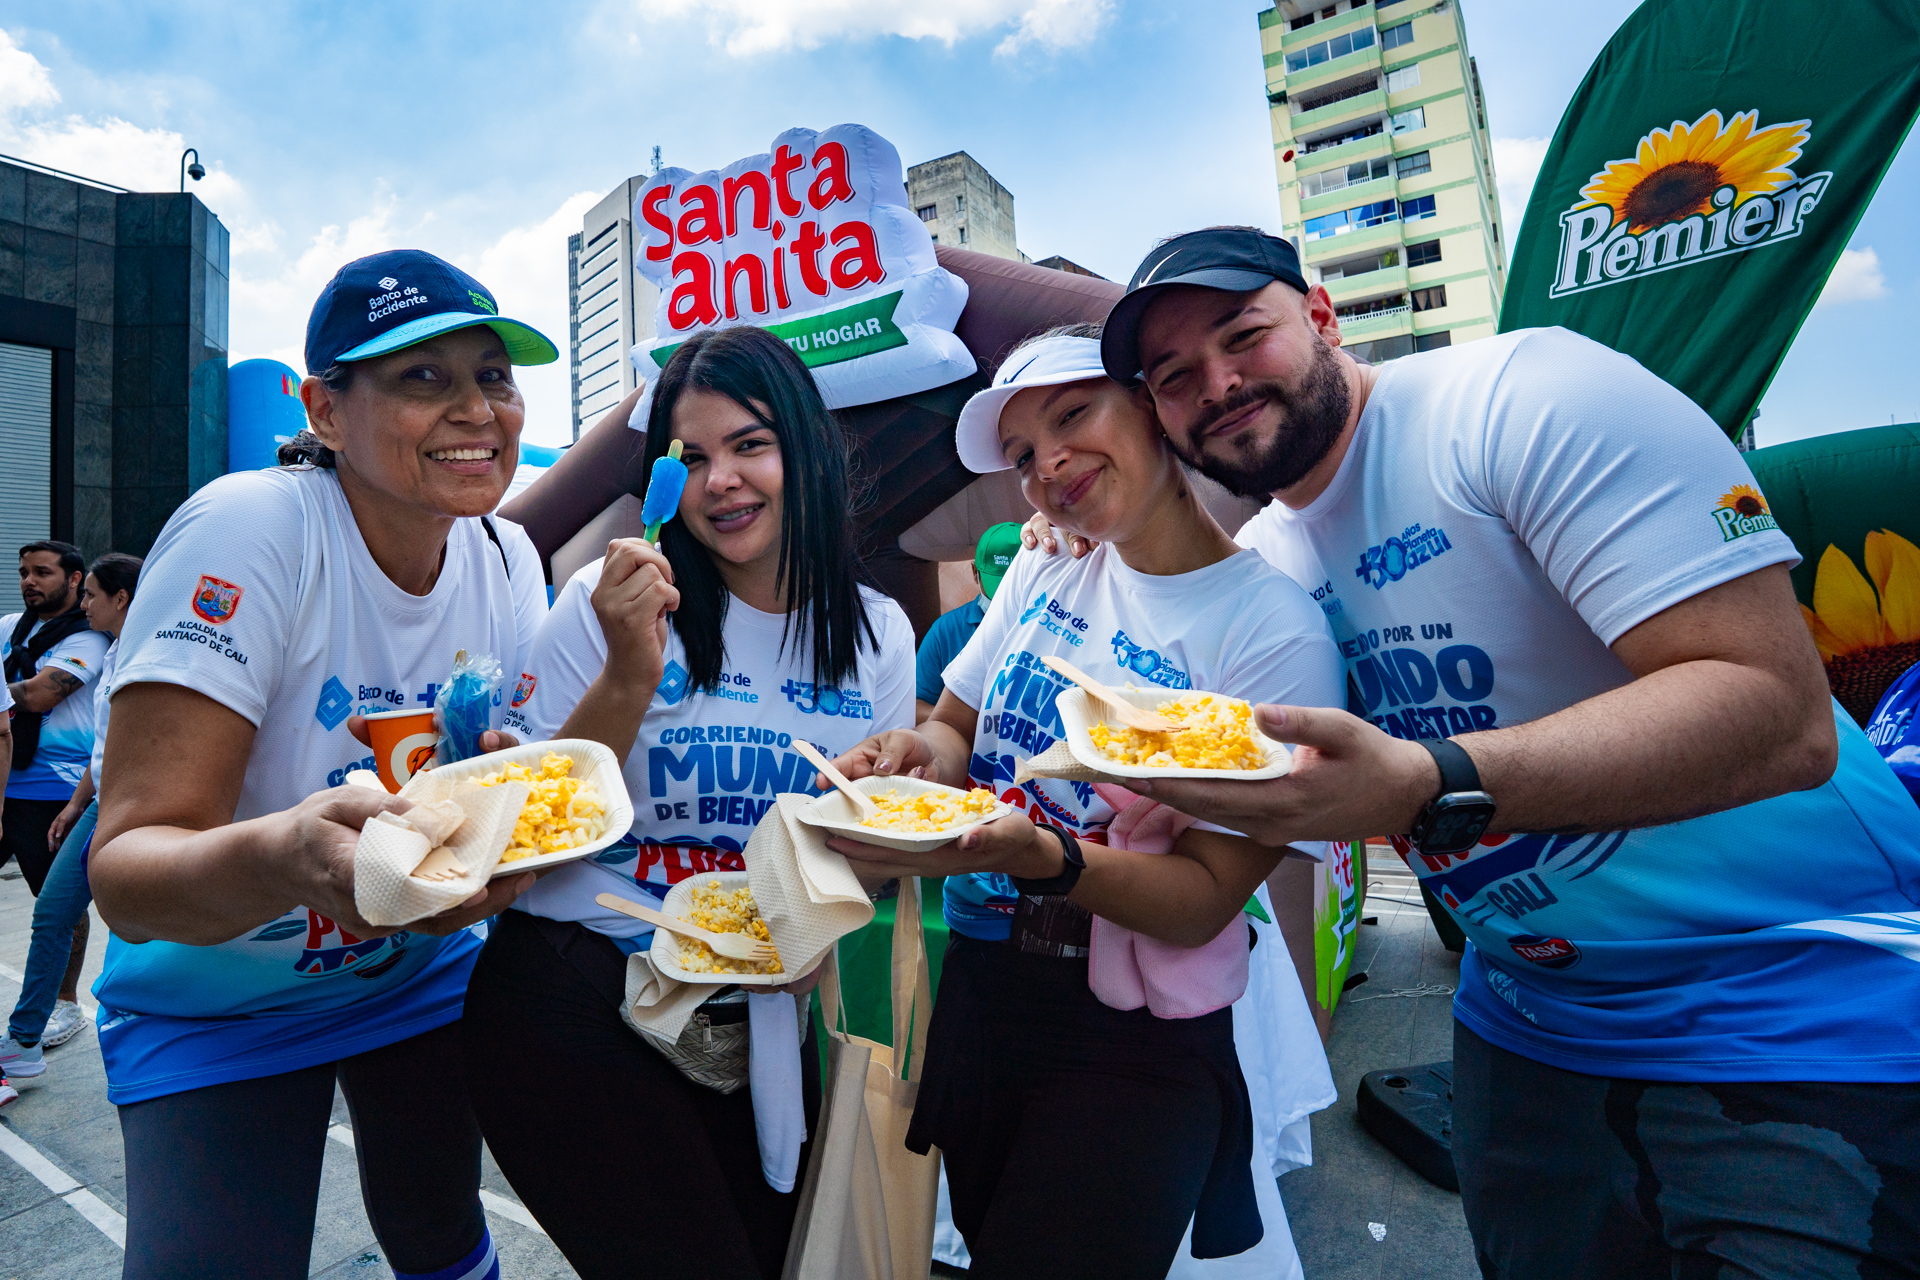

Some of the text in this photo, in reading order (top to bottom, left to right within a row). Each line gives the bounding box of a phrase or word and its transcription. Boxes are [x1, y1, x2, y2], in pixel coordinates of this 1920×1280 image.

[1554, 174, 1829, 293] Premier
[368, 286, 419, 310] Banco de
[368, 294, 428, 322] Occidente
[787, 317, 882, 353] TU HOGAR
[1401, 523, 1421, 541] AÑOS
[1711, 507, 1780, 541] Premie
[1402, 527, 1438, 550] Planeta
[1405, 529, 1452, 570] azul
[176, 621, 233, 645] ALCALDÍA DE
[1071, 617, 1089, 632] de
[1383, 623, 1453, 643] POR UN
[155, 630, 249, 665] SANTIAGO DE CALI
[733, 672, 751, 687] de
[1354, 644, 1495, 712] UNDO
[384, 689, 405, 705] de
[843, 688, 862, 698] AÑOS
[984, 664, 1068, 739] MUN
[840, 705, 874, 720] azu
[659, 725, 792, 748] CORRIENDO
[648, 743, 822, 798] MUND
[654, 801, 690, 821] DE
[1487, 872, 1559, 920] CALI
[1517, 942, 1567, 959] TASK
